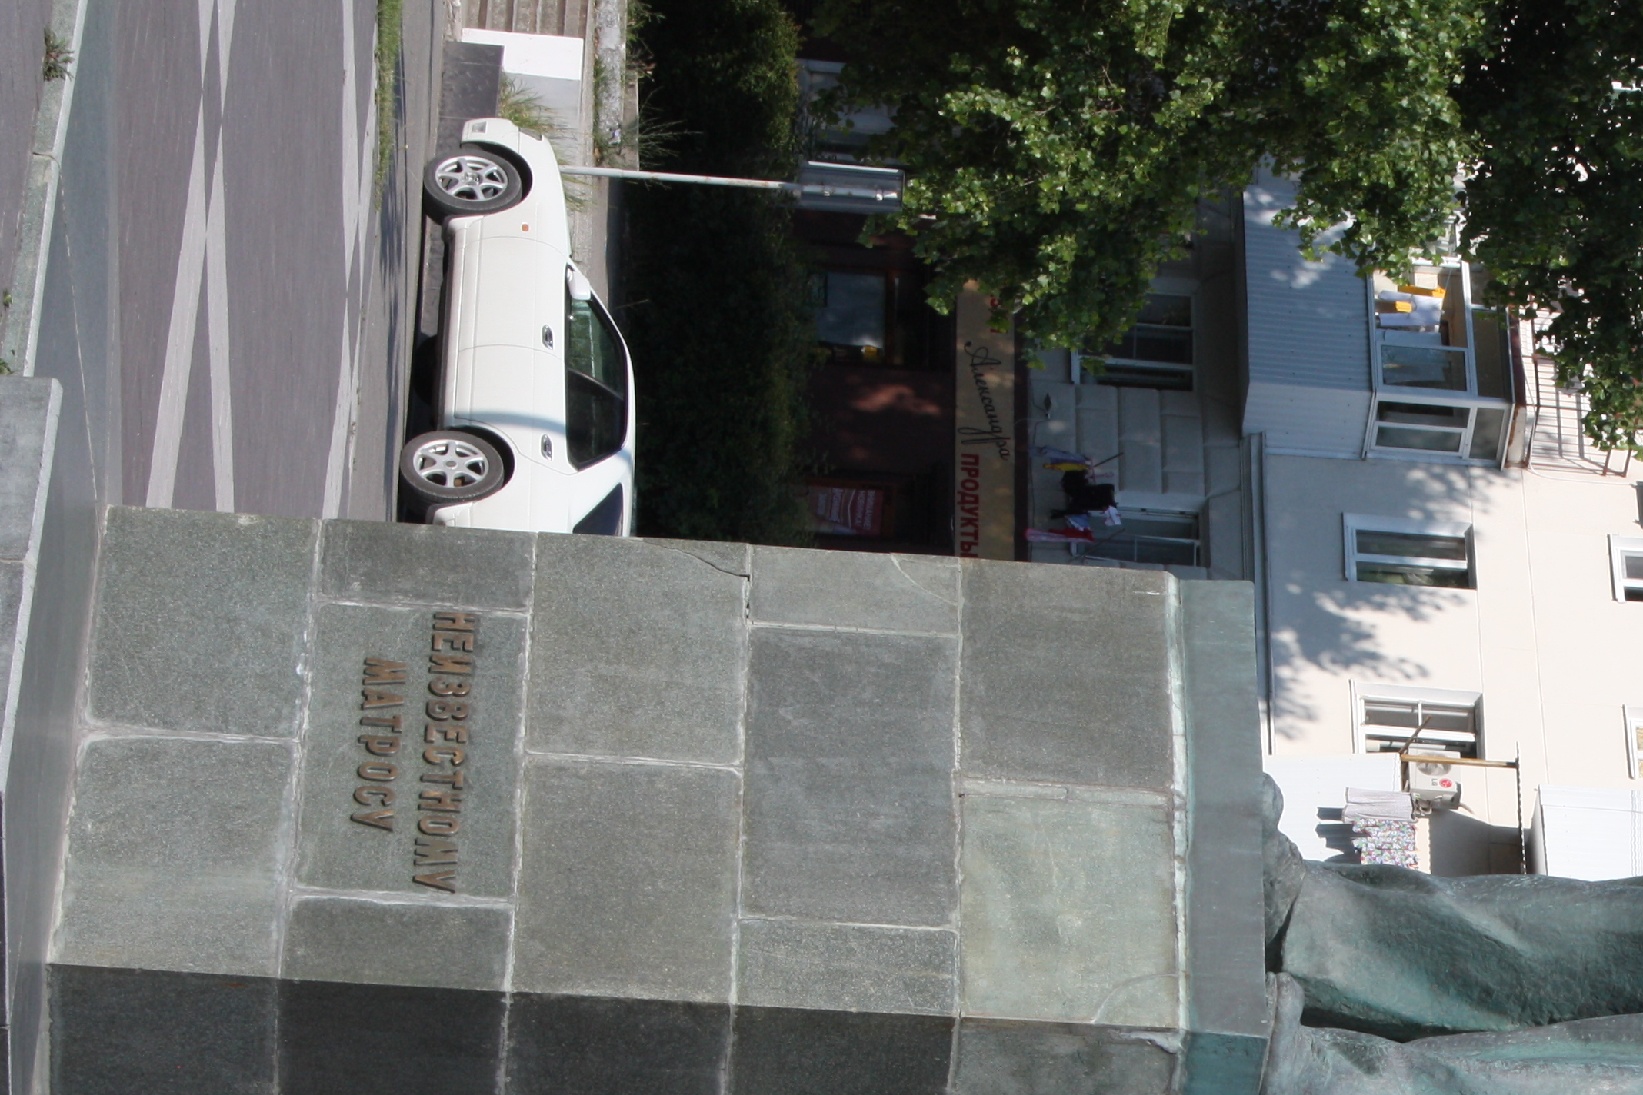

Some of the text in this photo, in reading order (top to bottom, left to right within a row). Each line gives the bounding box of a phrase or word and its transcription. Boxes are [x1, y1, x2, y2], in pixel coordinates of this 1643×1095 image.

[958, 341, 1011, 461] Александра
[958, 453, 979, 557] ПРОДУКТЫ
[351, 657, 408, 832] МАТРОСУ
[412, 612, 476, 894] НЕИЗВЕСТНОМУ
